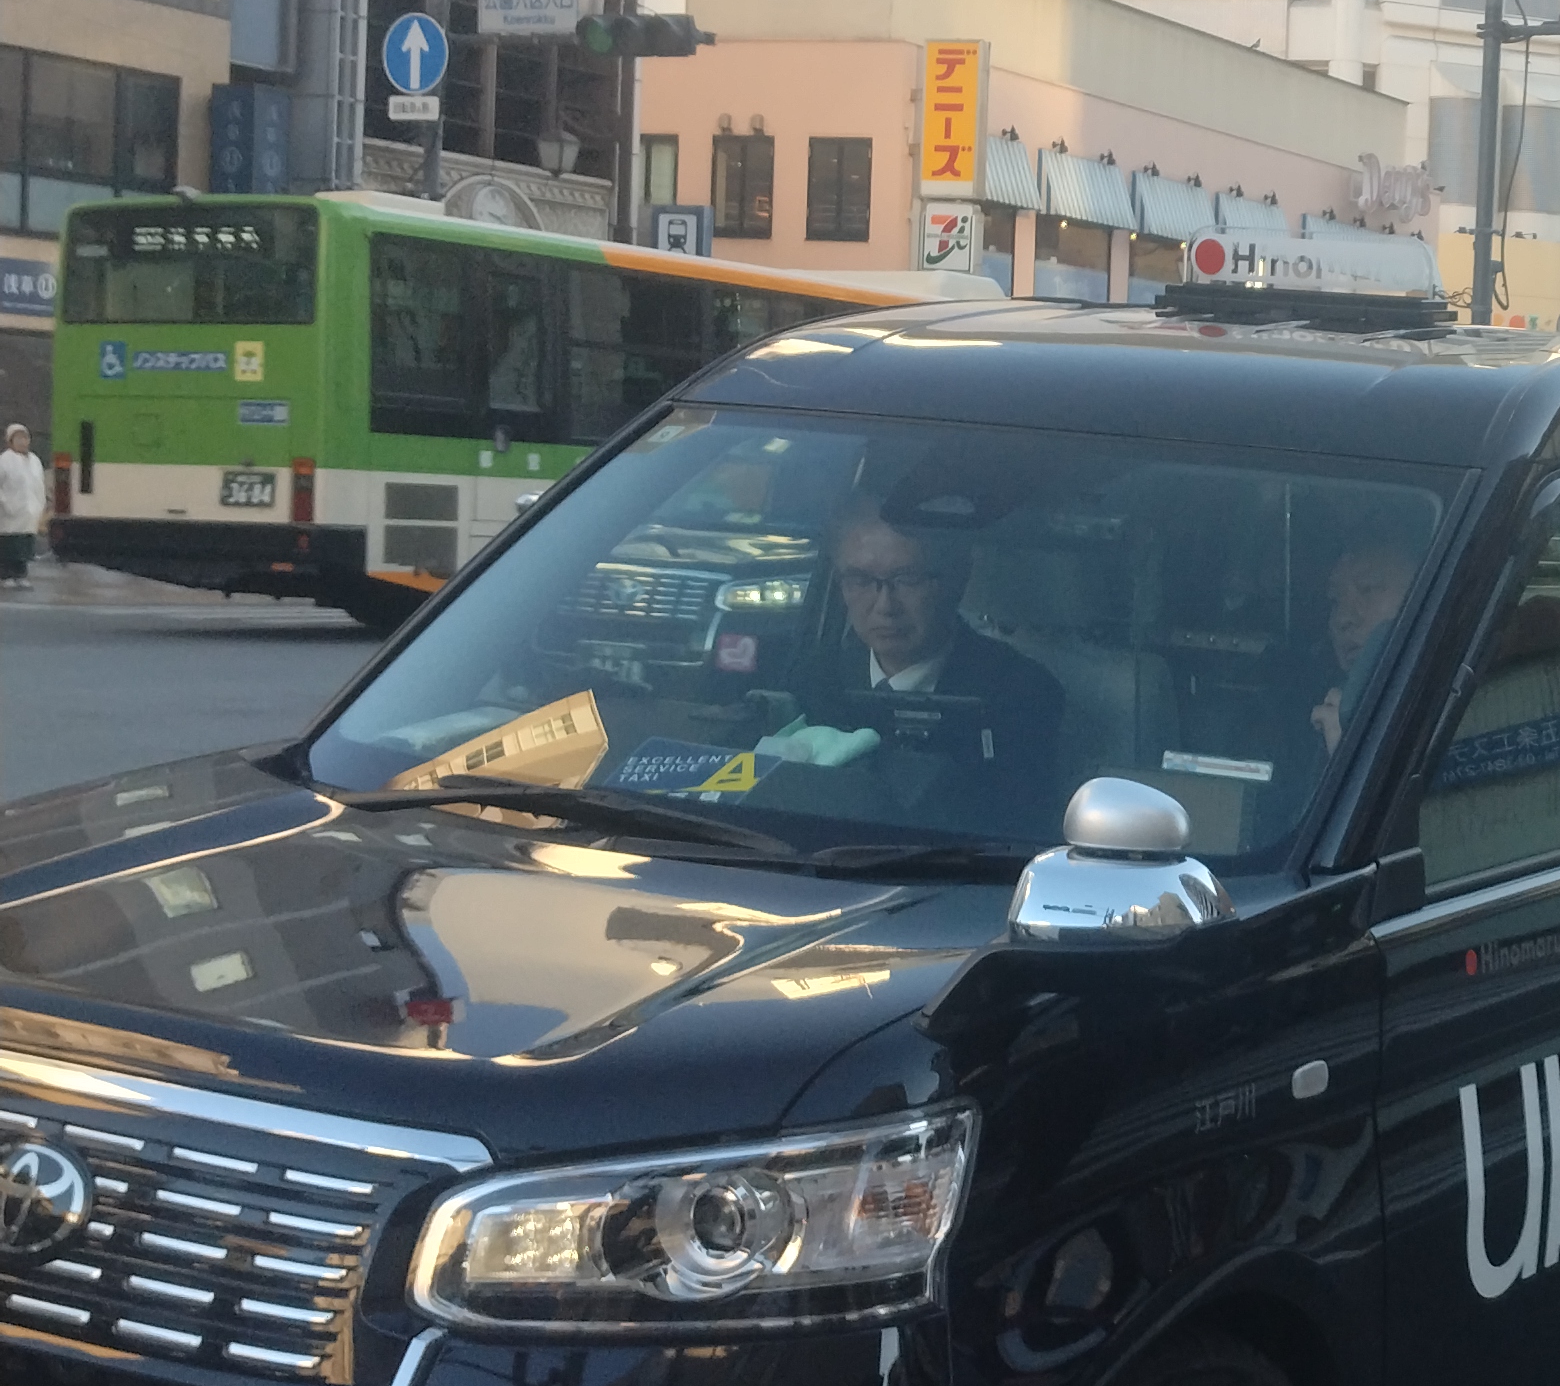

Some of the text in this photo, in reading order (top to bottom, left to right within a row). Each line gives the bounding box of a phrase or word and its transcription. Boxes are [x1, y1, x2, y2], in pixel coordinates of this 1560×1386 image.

[931, 48, 978, 178] デニーズ
[626, 754, 734, 765] EXCELLENT
[622, 764, 700, 774] SERVICE
[619, 773, 660, 783] TAXI
